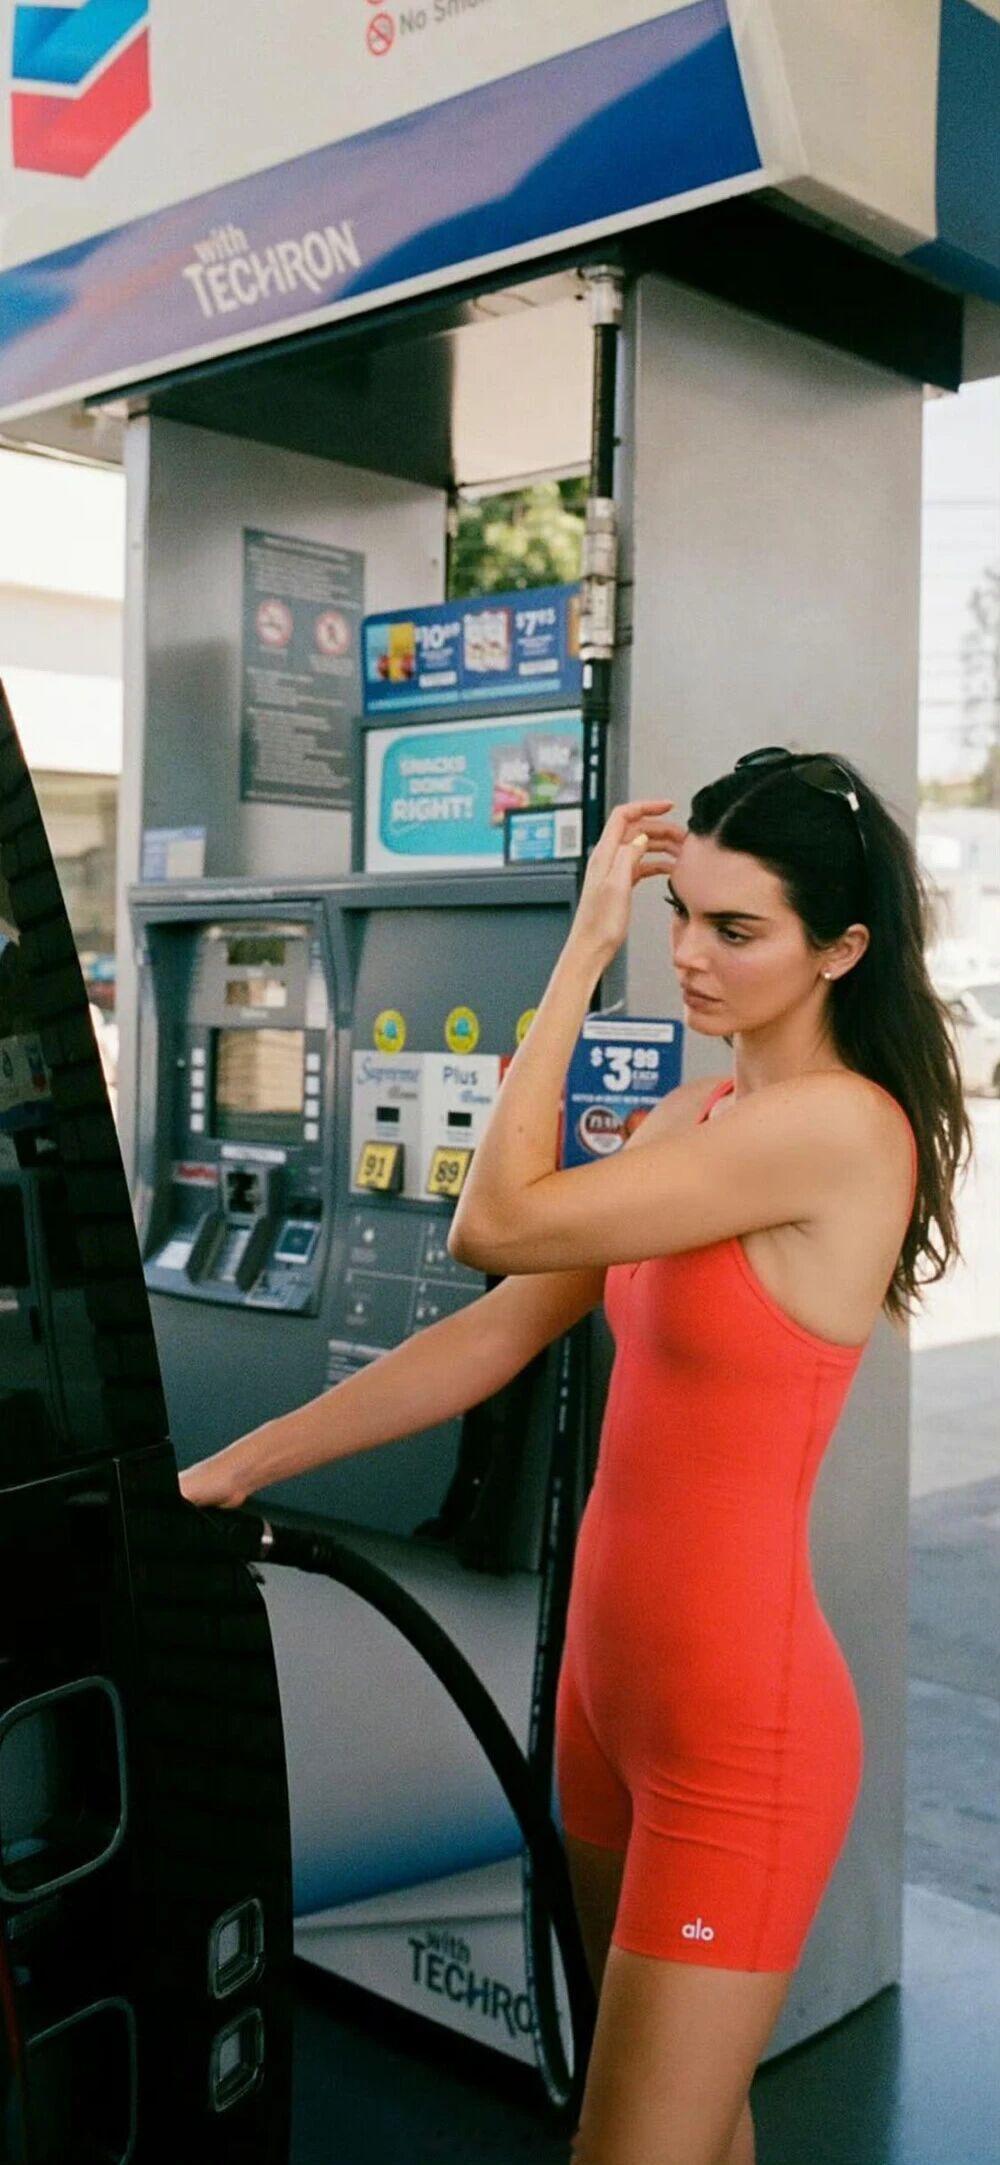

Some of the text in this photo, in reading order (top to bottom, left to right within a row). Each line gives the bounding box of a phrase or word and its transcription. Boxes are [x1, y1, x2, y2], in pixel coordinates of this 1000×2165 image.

[400, 9, 427, 35] No
[194, 224, 249, 264] with
[182, 220, 362, 319] TECHRON
[391, 795, 474, 822] RIGHT!
[358, 1056, 421, 1084] Supreme
[443, 1065, 478, 1086] Plus
[364, 1155, 387, 1178] 91
[435, 1160, 460, 1184] 89
[682, 1917, 715, 1941] alo
[425, 1930, 471, 1965] with
[408, 1937, 537, 2039] TECHRO
